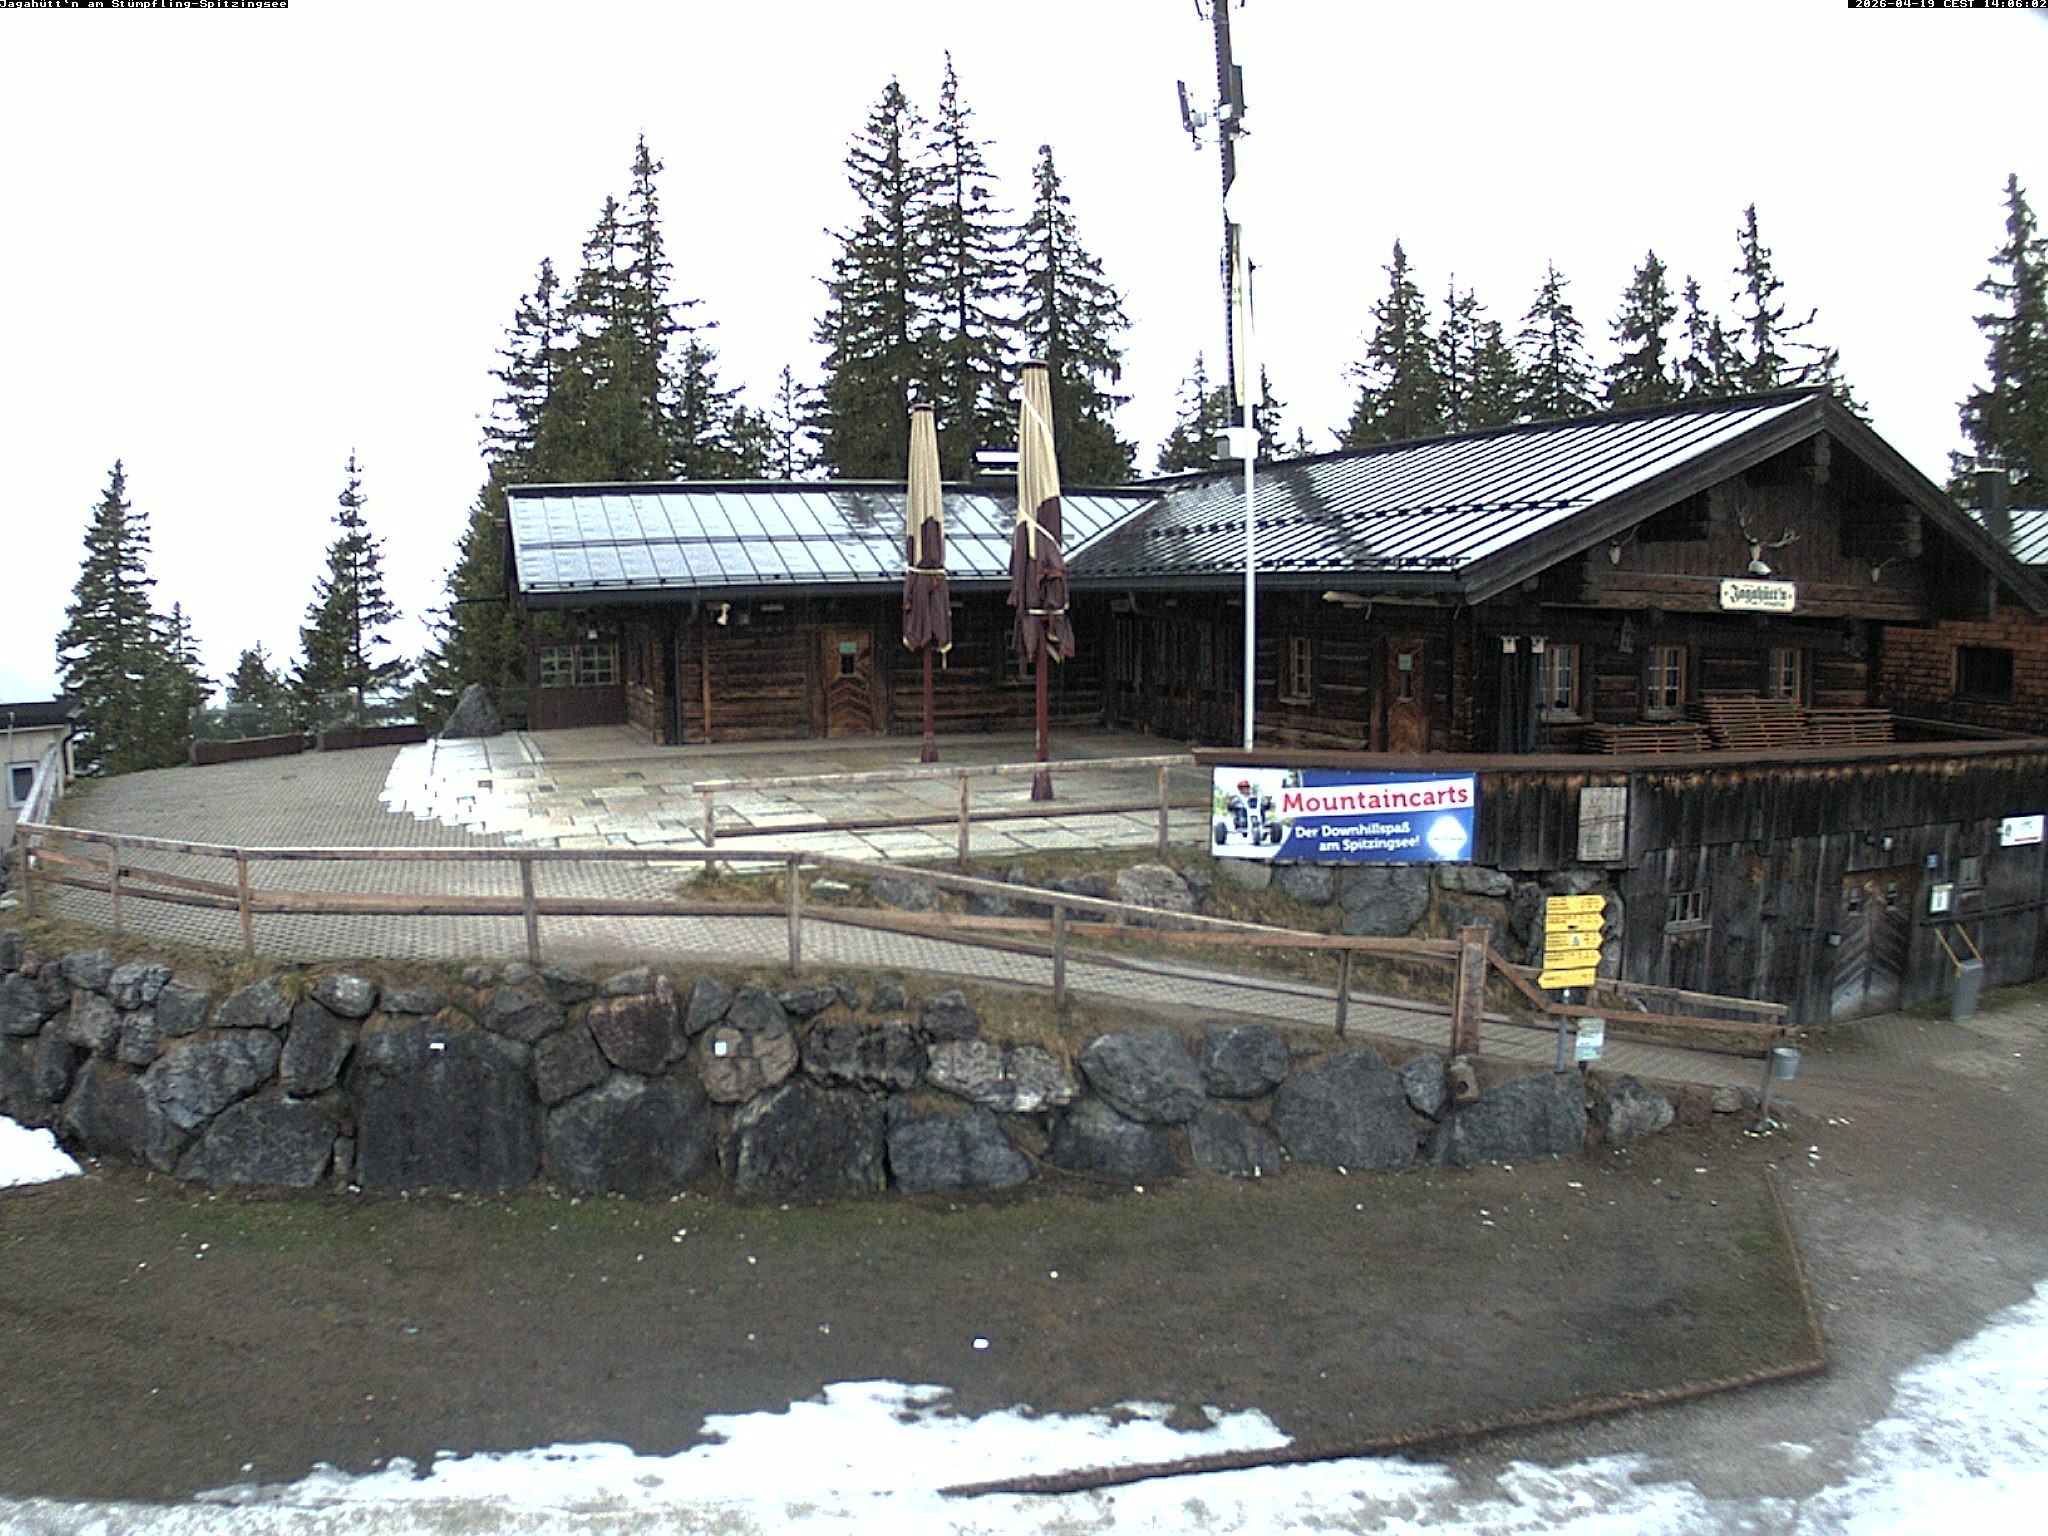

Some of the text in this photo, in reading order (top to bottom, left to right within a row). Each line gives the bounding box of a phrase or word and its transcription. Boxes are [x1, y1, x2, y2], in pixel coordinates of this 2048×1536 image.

[1282, 786, 1469, 813] Mountaincarts
[1295, 822, 1411, 839] Der Downhillspaß
[1319, 835, 1420, 853] am Spitzingsee!
